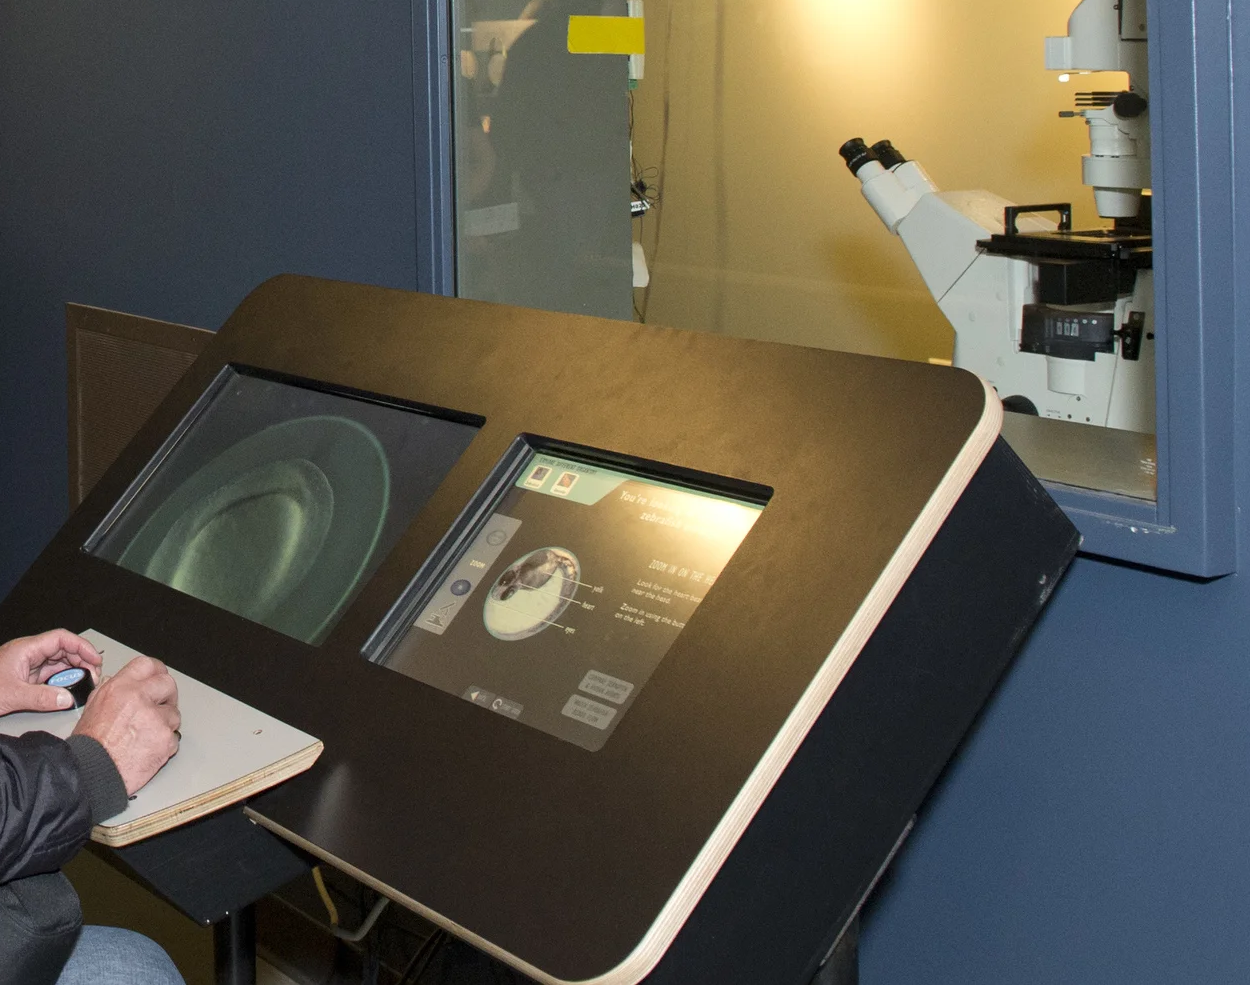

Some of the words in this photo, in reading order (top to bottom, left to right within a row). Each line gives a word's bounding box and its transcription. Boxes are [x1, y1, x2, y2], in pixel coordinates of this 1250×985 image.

[619, 490, 648, 505] You're
[649, 560, 668, 570] ZOOM
[620, 603, 638, 613] Zoom
